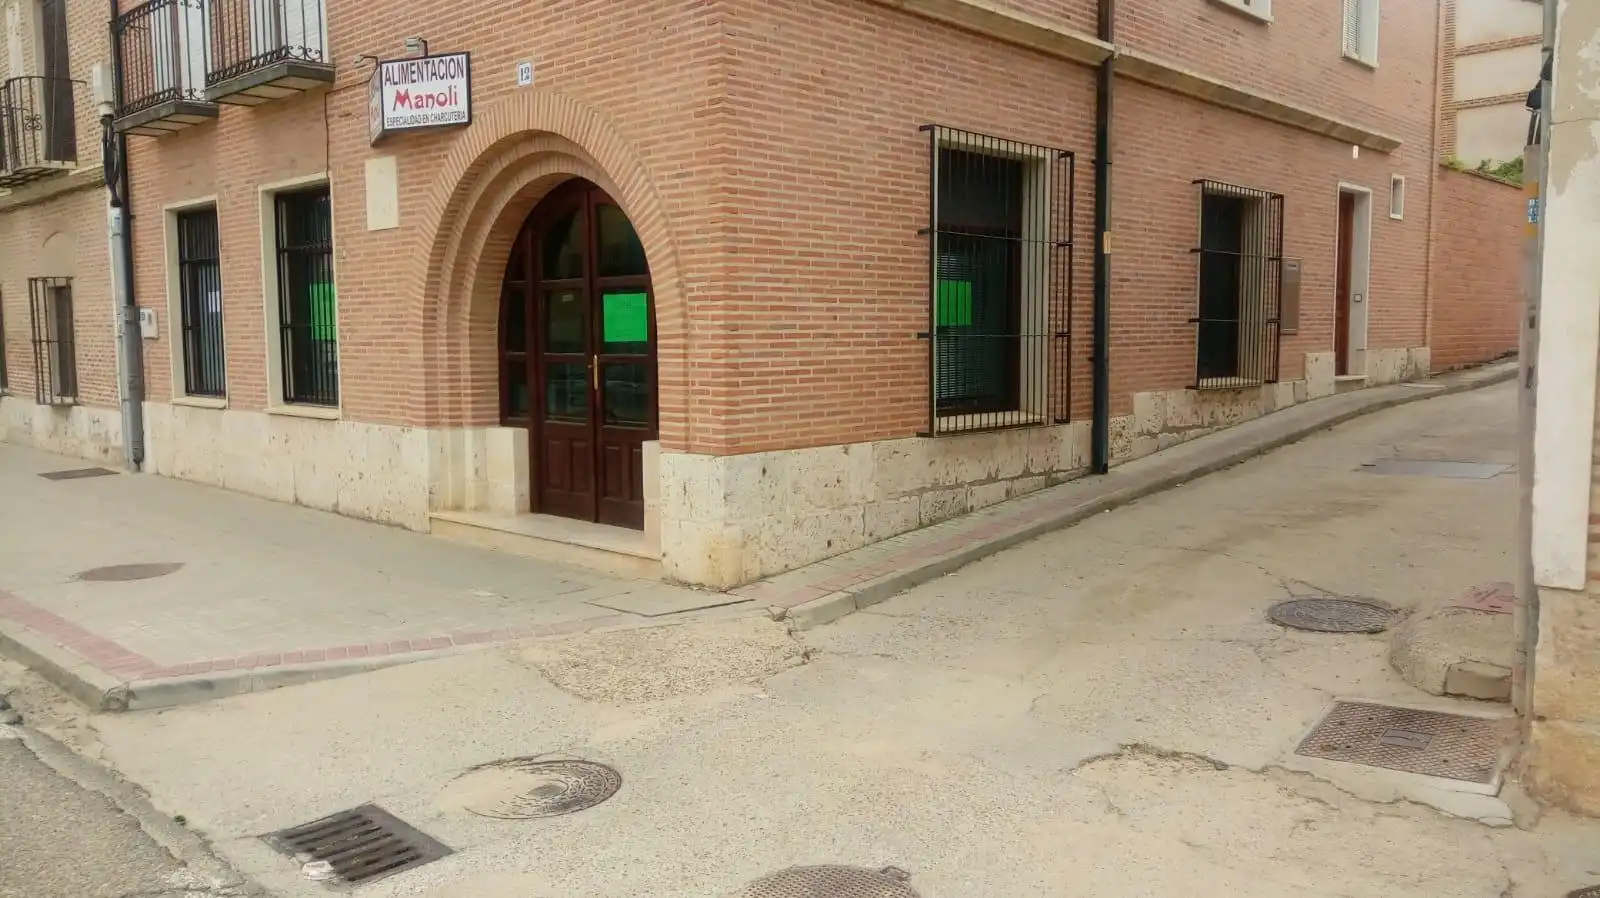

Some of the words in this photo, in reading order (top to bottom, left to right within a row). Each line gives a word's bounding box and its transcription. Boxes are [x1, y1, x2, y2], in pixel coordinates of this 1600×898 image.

[384, 56, 464, 87] ALIMENTACION
[392, 85, 458, 112] Manoli
[386, 115, 422, 127] ESPECIALIDAD
[422, 113, 430, 123] EN
[430, 110, 466, 123] CHARCUTERIA
